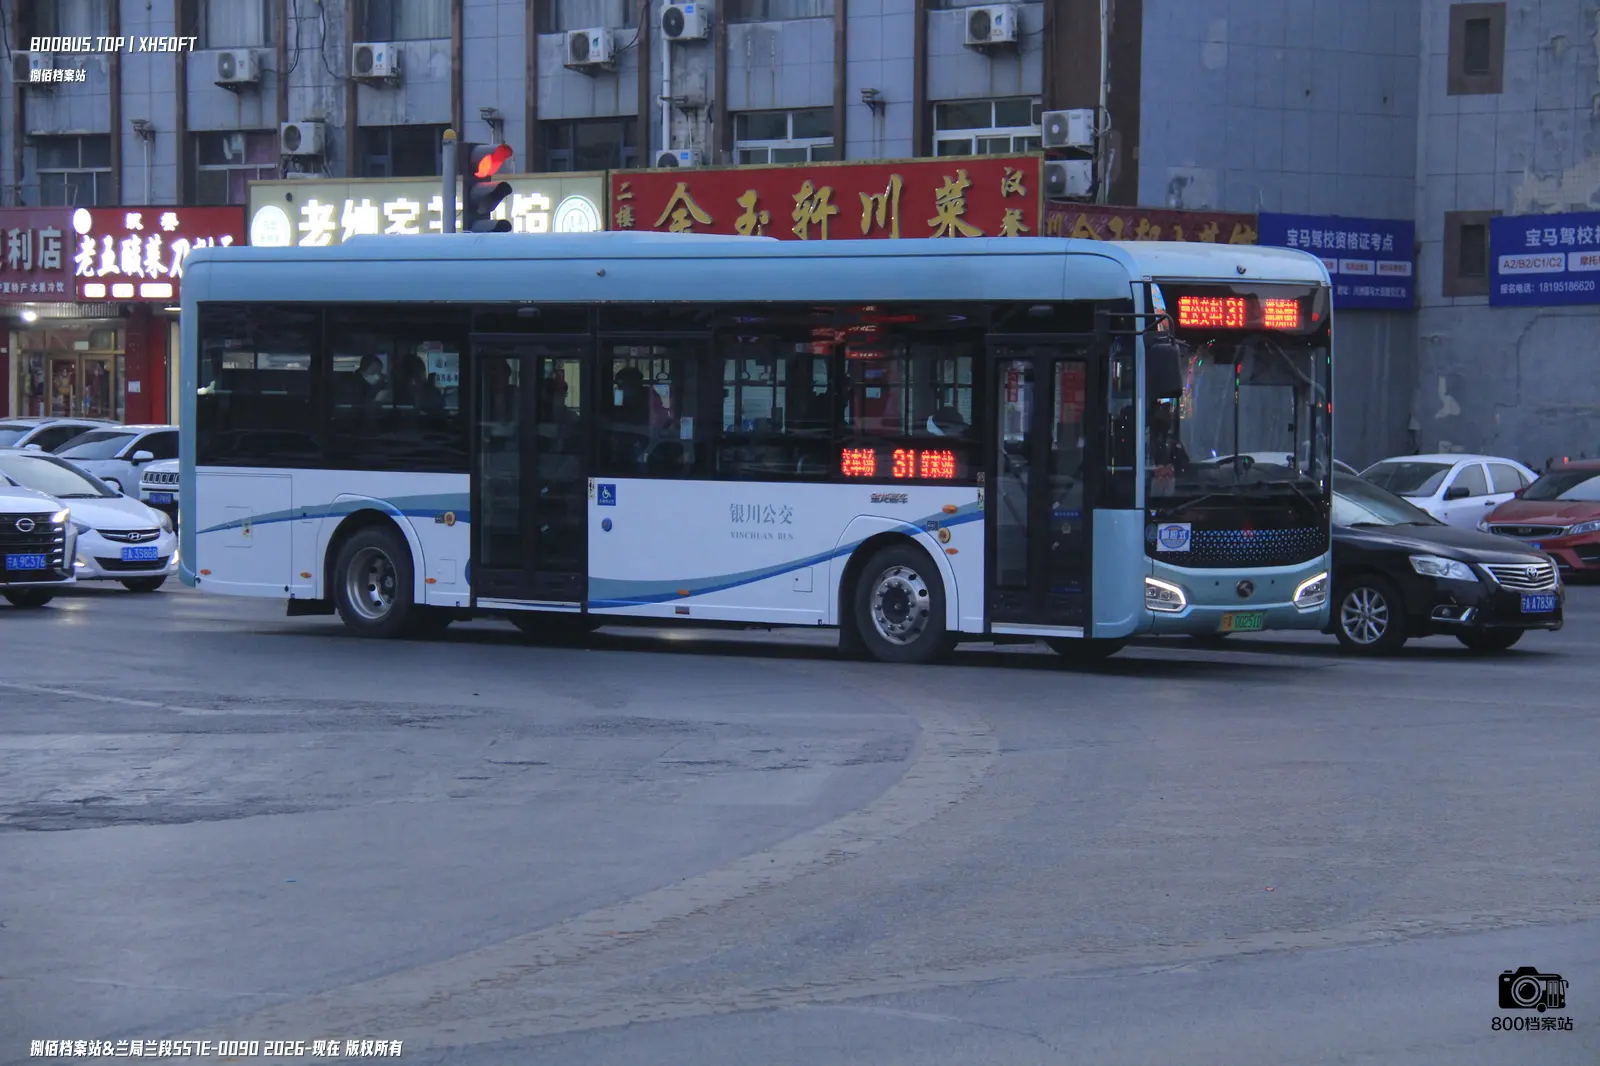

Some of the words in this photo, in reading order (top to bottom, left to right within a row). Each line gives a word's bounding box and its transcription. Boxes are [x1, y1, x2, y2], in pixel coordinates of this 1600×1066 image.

[0, 225, 62, 270] 利店
[1286, 228, 1394, 252] 宝马驾校资格证考点
[1503, 257, 1562, 269] A2/B2/C1/C2
[893, 448, 915, 478] 31
[729, 503, 794, 525] 银川公交
[730, 531, 774, 540] YINCHUAN
[778, 532, 794, 540] BUS
